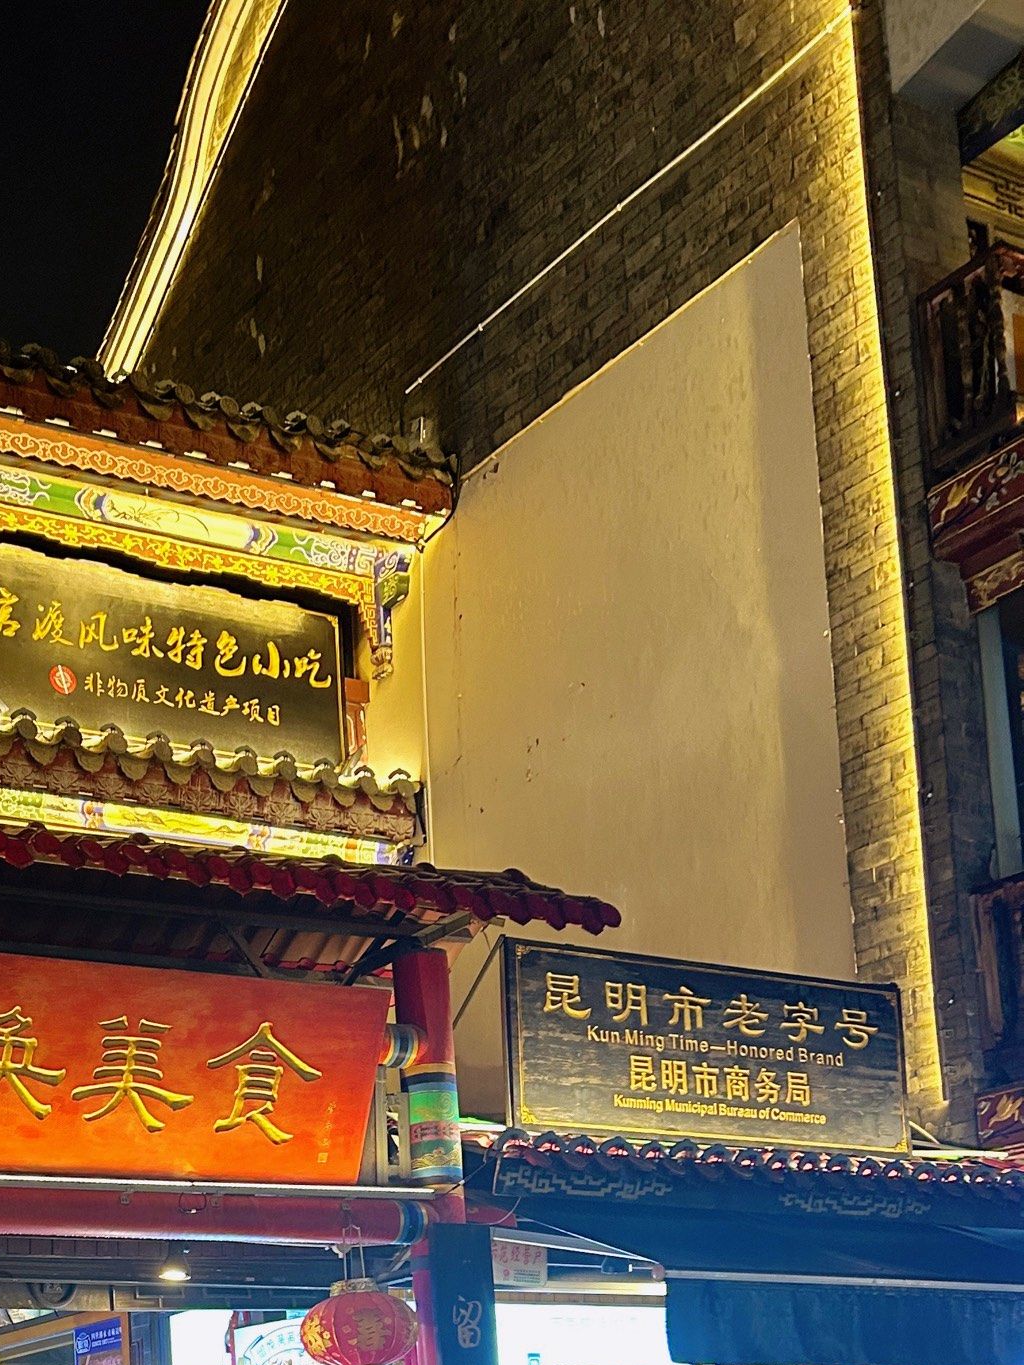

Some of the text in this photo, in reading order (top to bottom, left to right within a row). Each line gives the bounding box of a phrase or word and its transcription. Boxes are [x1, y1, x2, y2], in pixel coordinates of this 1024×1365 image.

[84, 672, 281, 727] 非物质文化遗产项目
[542, 971, 878, 1050] 昆明市老字号
[587, 1025, 621, 1044] Kun
[624, 1029, 665, 1052] Ming
[798, 1048, 845, 1067] Brand
[629, 1055, 812, 1107] 昆明市商务局
[613, 1094, 827, 1125] Kunming Municipal Bureau of Commerce
